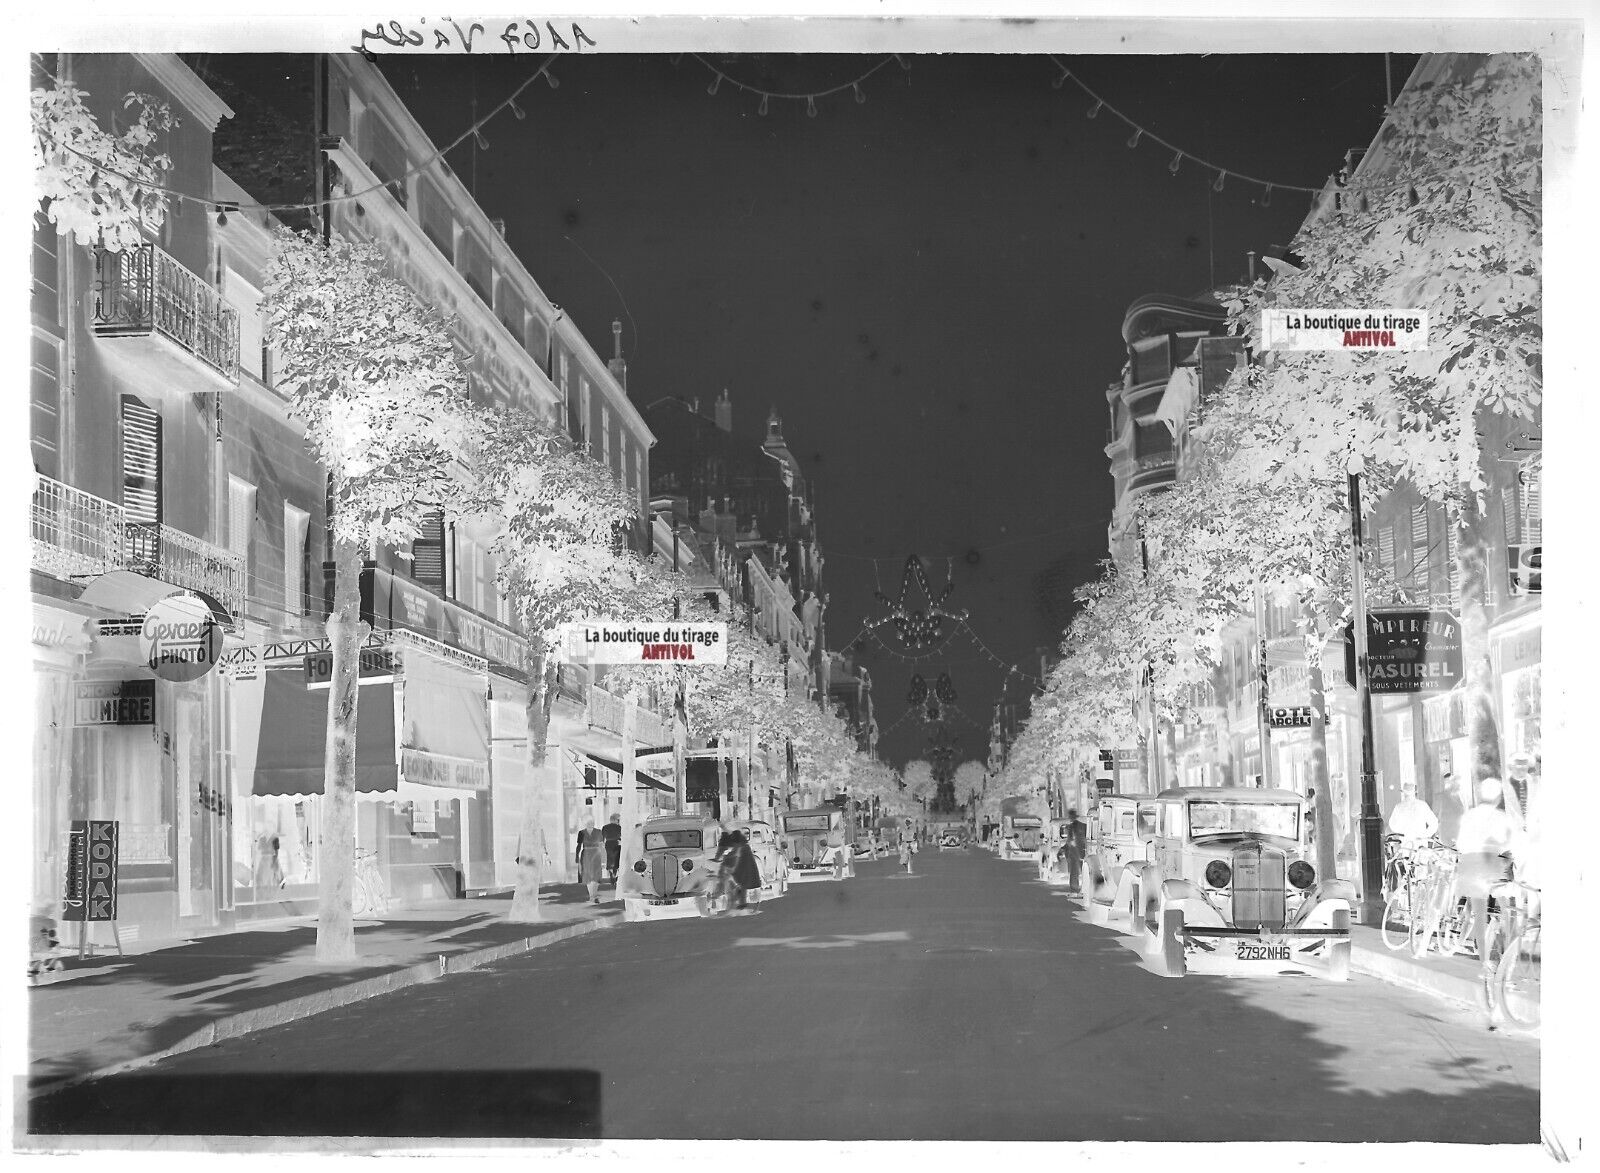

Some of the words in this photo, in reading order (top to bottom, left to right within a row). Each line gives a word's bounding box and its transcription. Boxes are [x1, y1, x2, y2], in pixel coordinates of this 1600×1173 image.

[143, 615, 219, 670] Gevaert
[161, 647, 206, 664] PHOTO
[307, 650, 405, 678] FOURES
[91, 823, 112, 919] KODAK
[1237, 946, 1291, 961] 2792NH6
